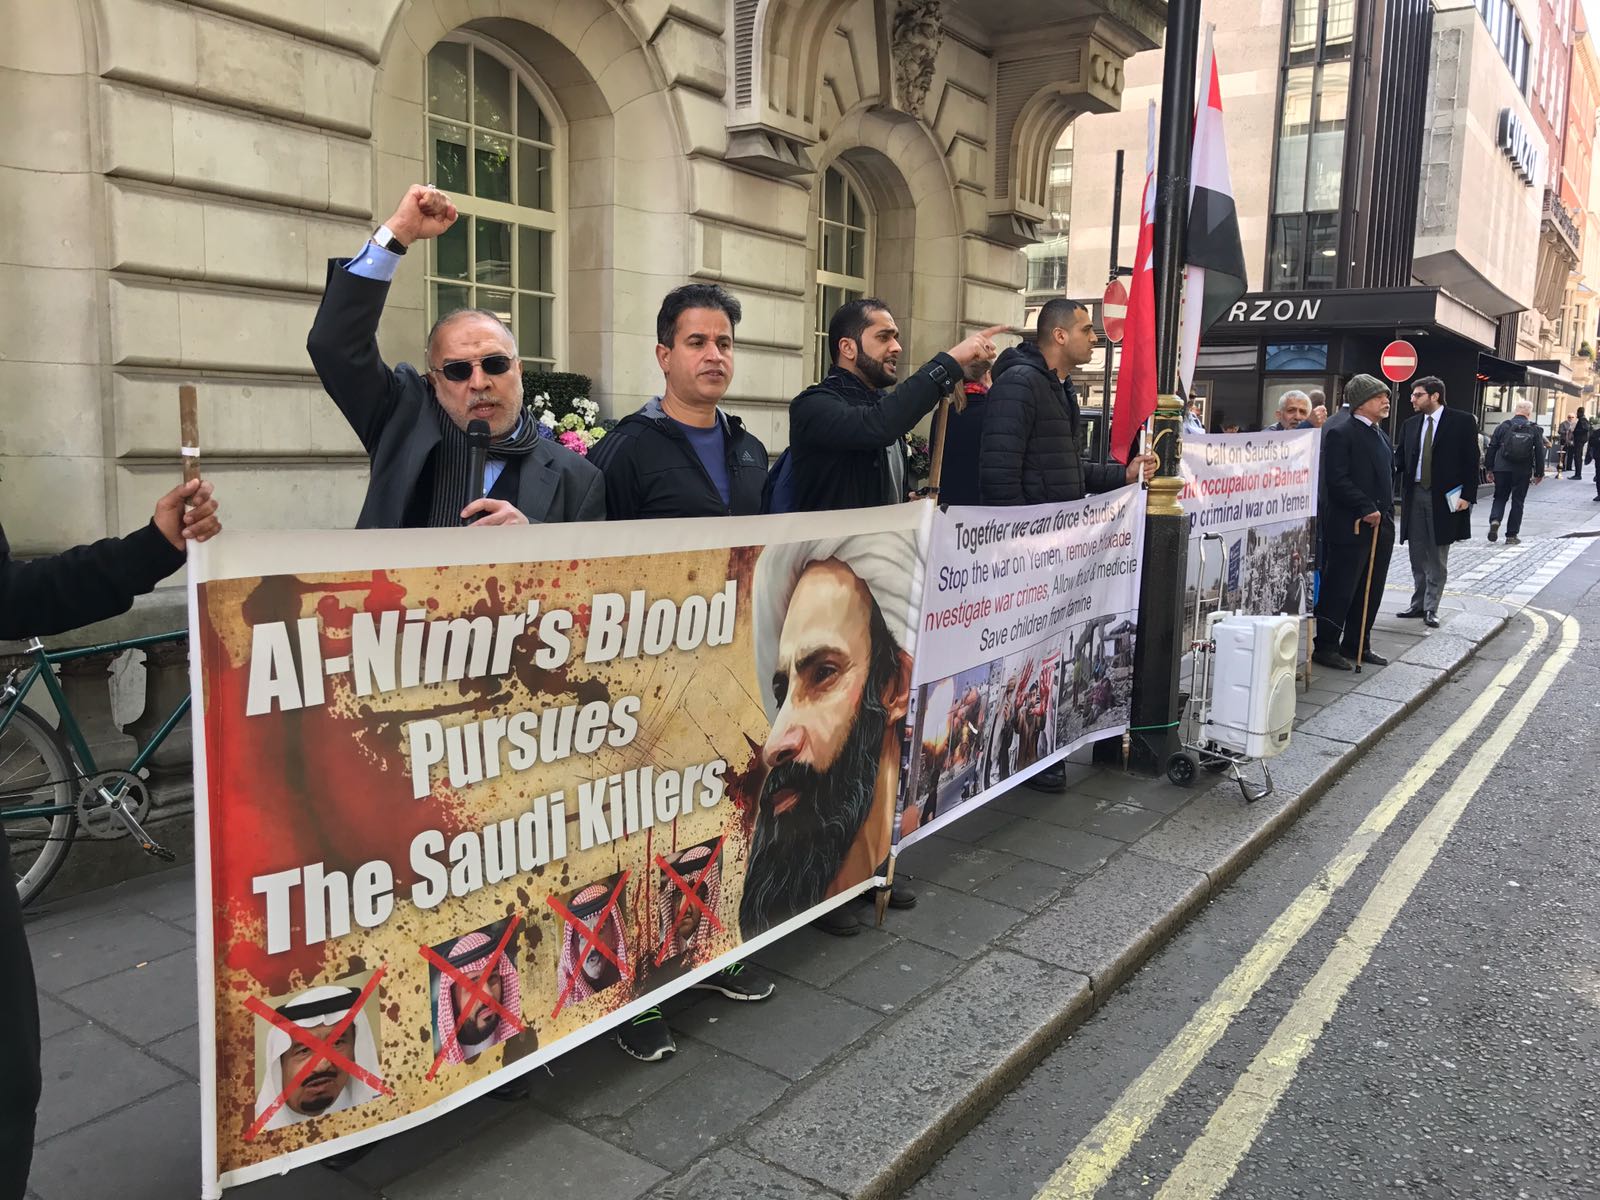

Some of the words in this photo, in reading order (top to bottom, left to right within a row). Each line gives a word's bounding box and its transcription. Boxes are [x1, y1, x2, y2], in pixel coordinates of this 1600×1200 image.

[1205, 441, 1226, 466] Call
[1229, 447, 1242, 464] on
[1245, 440, 1278, 462] Saudis
[1280, 440, 1290, 460] to
[1177, 474, 1197, 500] nd
[1200, 470, 1260, 499] occupation
[1262, 467, 1272, 489] of
[1274, 465, 1310, 487] Bahrain
[955, 518, 1009, 554] Together
[1010, 520, 1027, 538] we
[1029, 516, 1050, 536] can
[1052, 510, 1080, 532] force
[1082, 501, 1116, 527] Saudis
[1200, 499, 1243, 527] criminal
[1245, 502, 1264, 519] war
[1265, 499, 1278, 515] on
[1280, 493, 1310, 513] Yemen
[938, 566, 968, 594] Stop
[972, 560, 989, 585] the
[992, 558, 1011, 579] war
[1012, 552, 1026, 573] on
[1027, 547, 1064, 571] Yemen,
[1066, 540, 1098, 561] remove
[994, 592, 1014, 613] war
[1015, 583, 1050, 607] crimes,
[1052, 573, 1076, 596] Allow
[583, 579, 738, 664] Blood
[979, 628, 1008, 652] Save
[1010, 612, 1048, 640] children
[1048, 606, 1067, 627] from
[1066, 594, 1092, 618] famine
[407, 695, 641, 800] Pursues
[252, 857, 394, 956] The
[409, 790, 567, 911] Saudi
[577, 758, 728, 851] Killers
